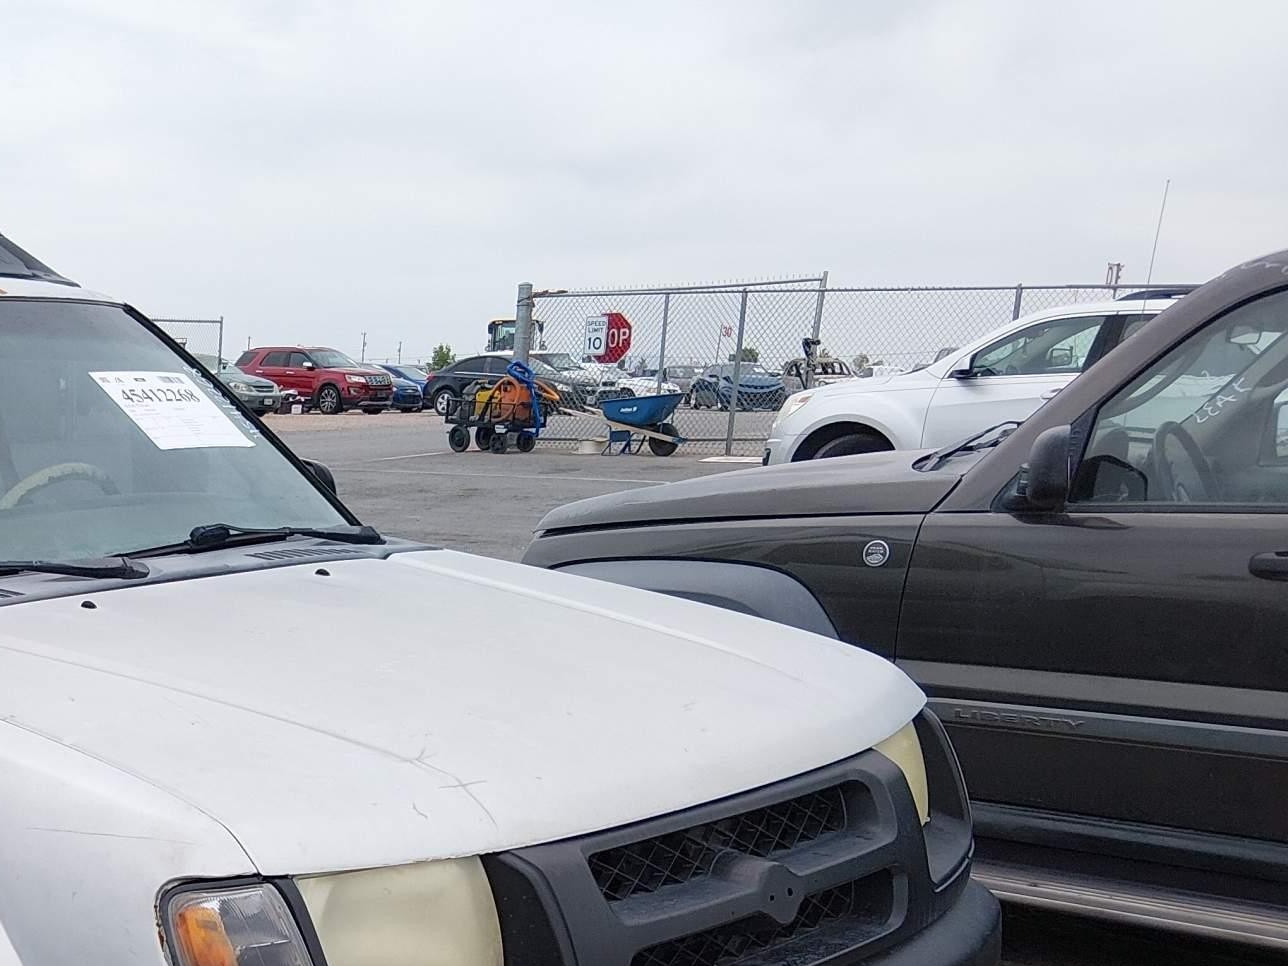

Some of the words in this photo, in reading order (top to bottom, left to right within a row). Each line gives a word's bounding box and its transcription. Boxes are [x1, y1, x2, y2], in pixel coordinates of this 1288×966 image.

[587, 336, 603, 350] 10
[121, 388, 201, 403] 45412268
[954, 708, 1086, 728] LIBERTY
